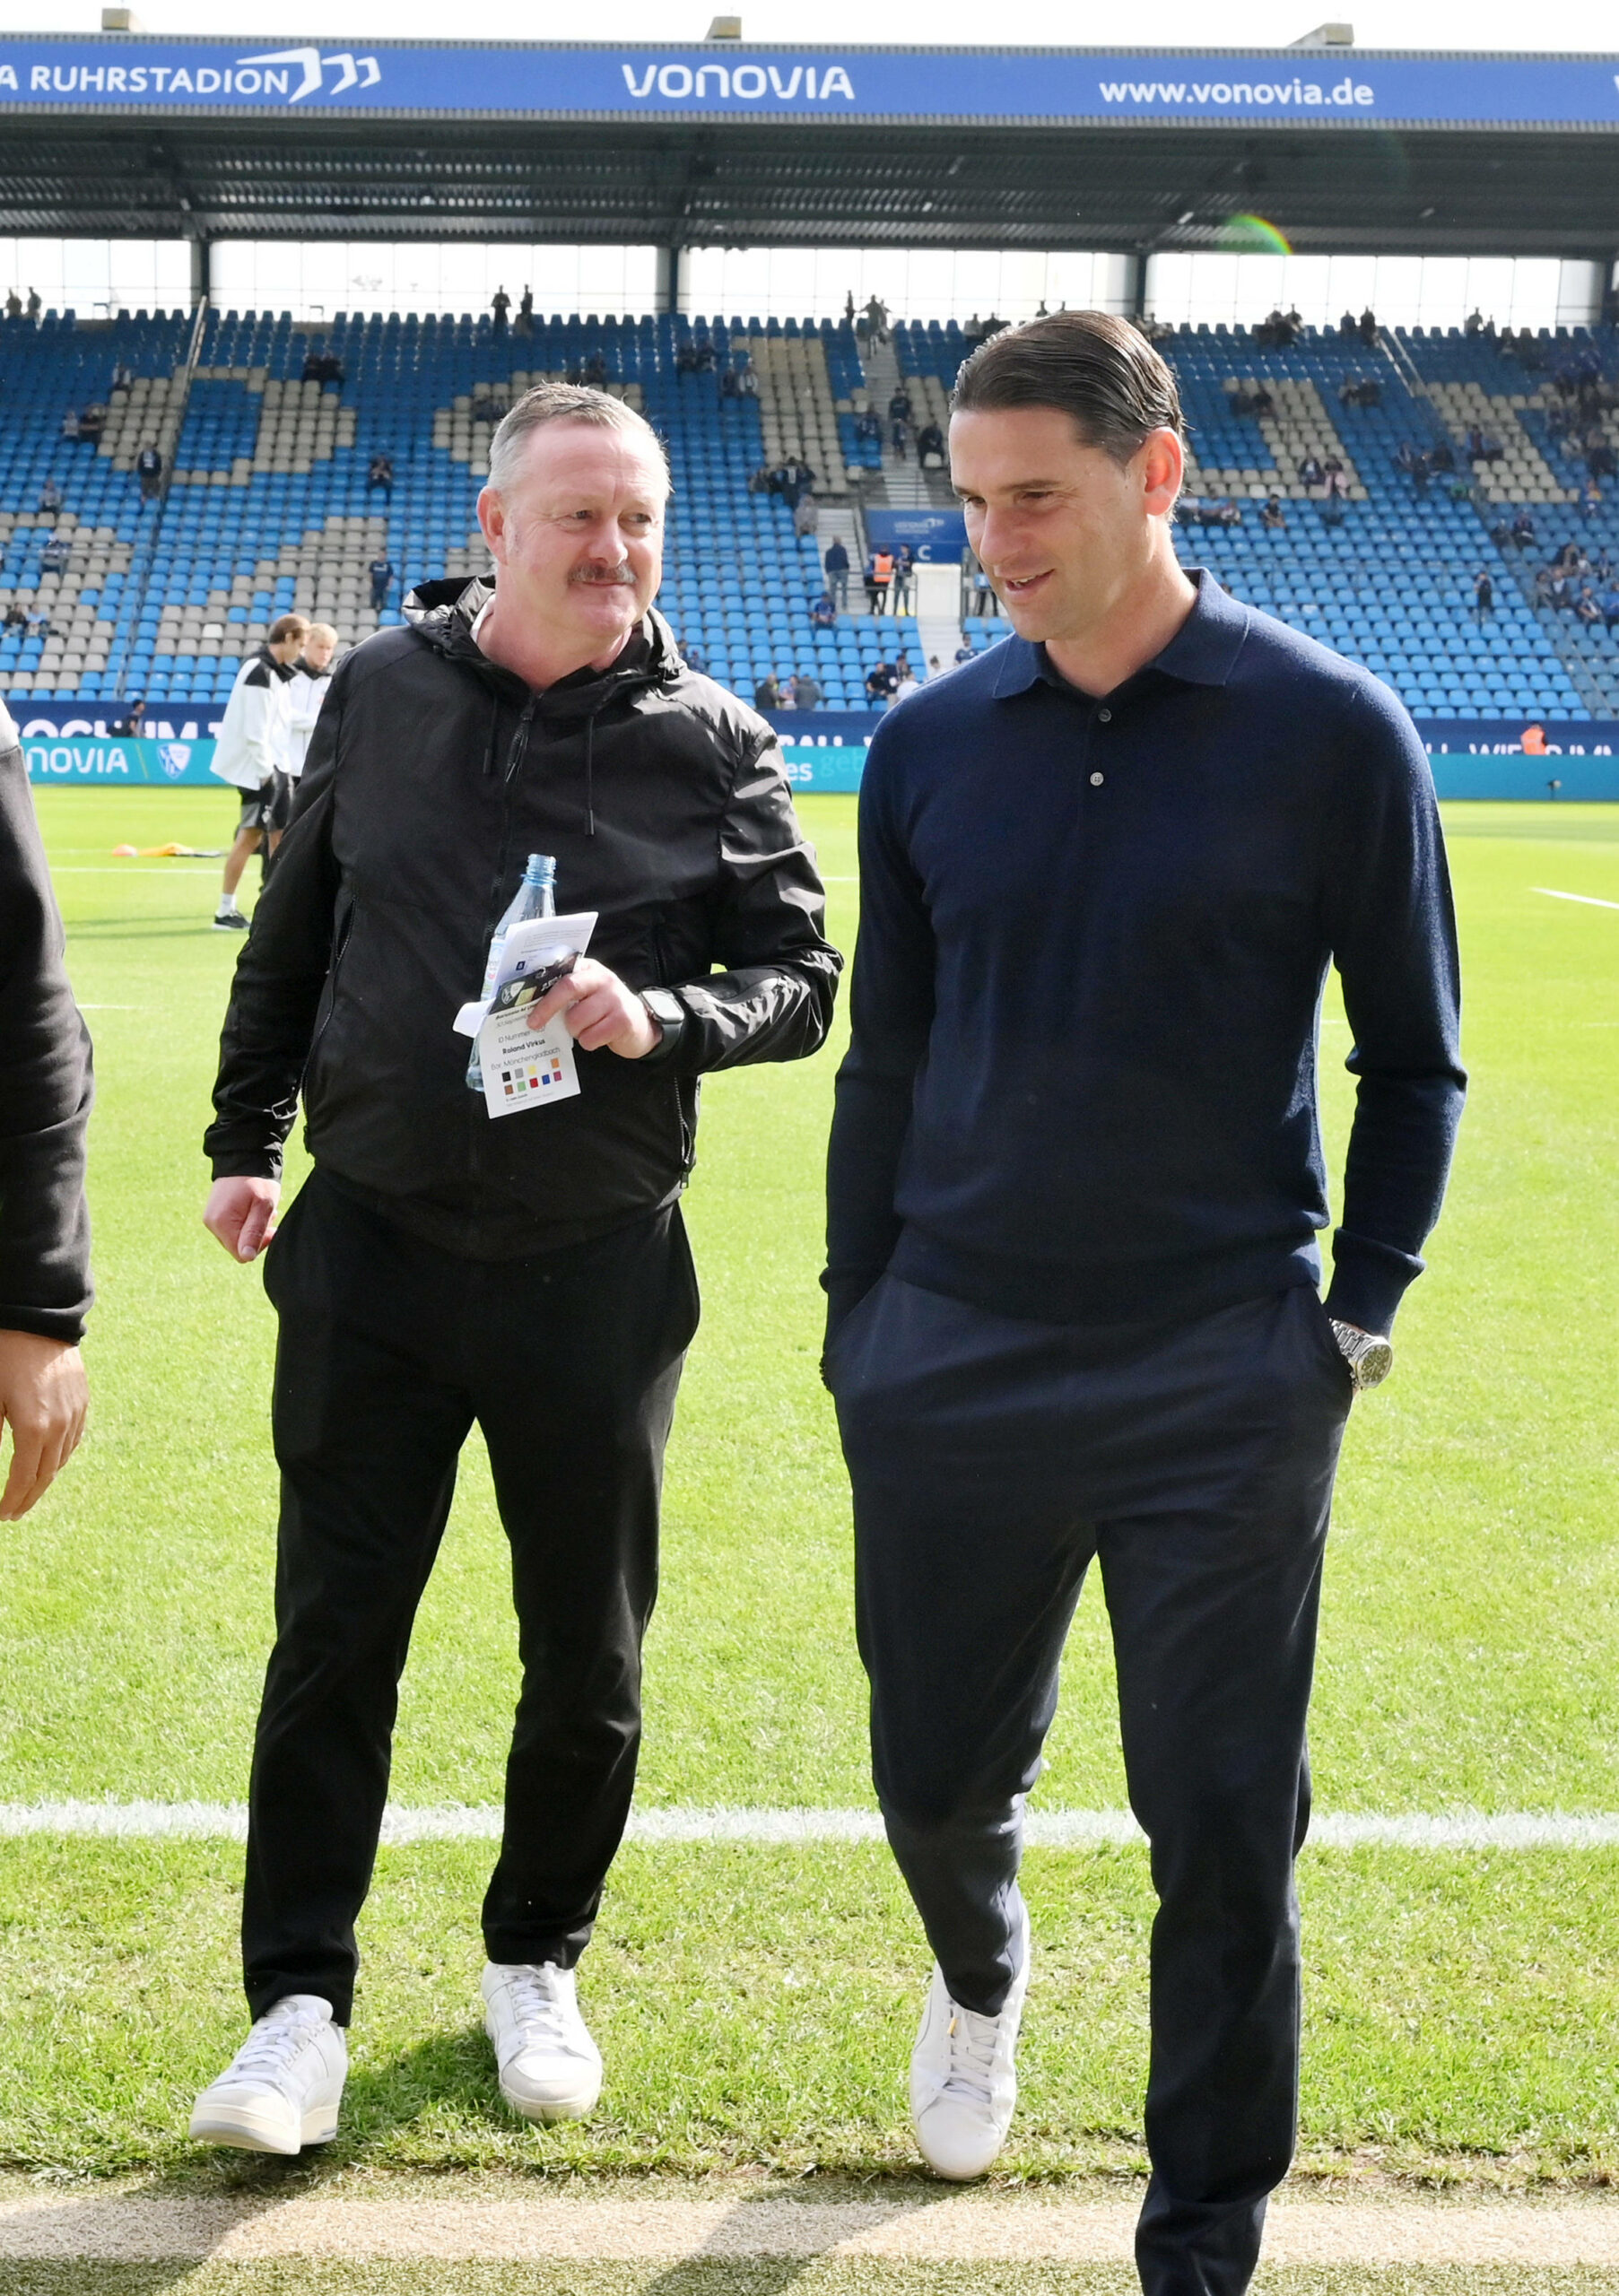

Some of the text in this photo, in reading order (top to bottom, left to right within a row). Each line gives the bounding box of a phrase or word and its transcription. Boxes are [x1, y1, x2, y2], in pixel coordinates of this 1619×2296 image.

[30, 65, 289, 94] RUHRSTADION
[622, 64, 855, 100] VONOVIA
[1099, 77, 1375, 106] www.vonovia.de
[502, 1039, 546, 1055] Roland Virkus
